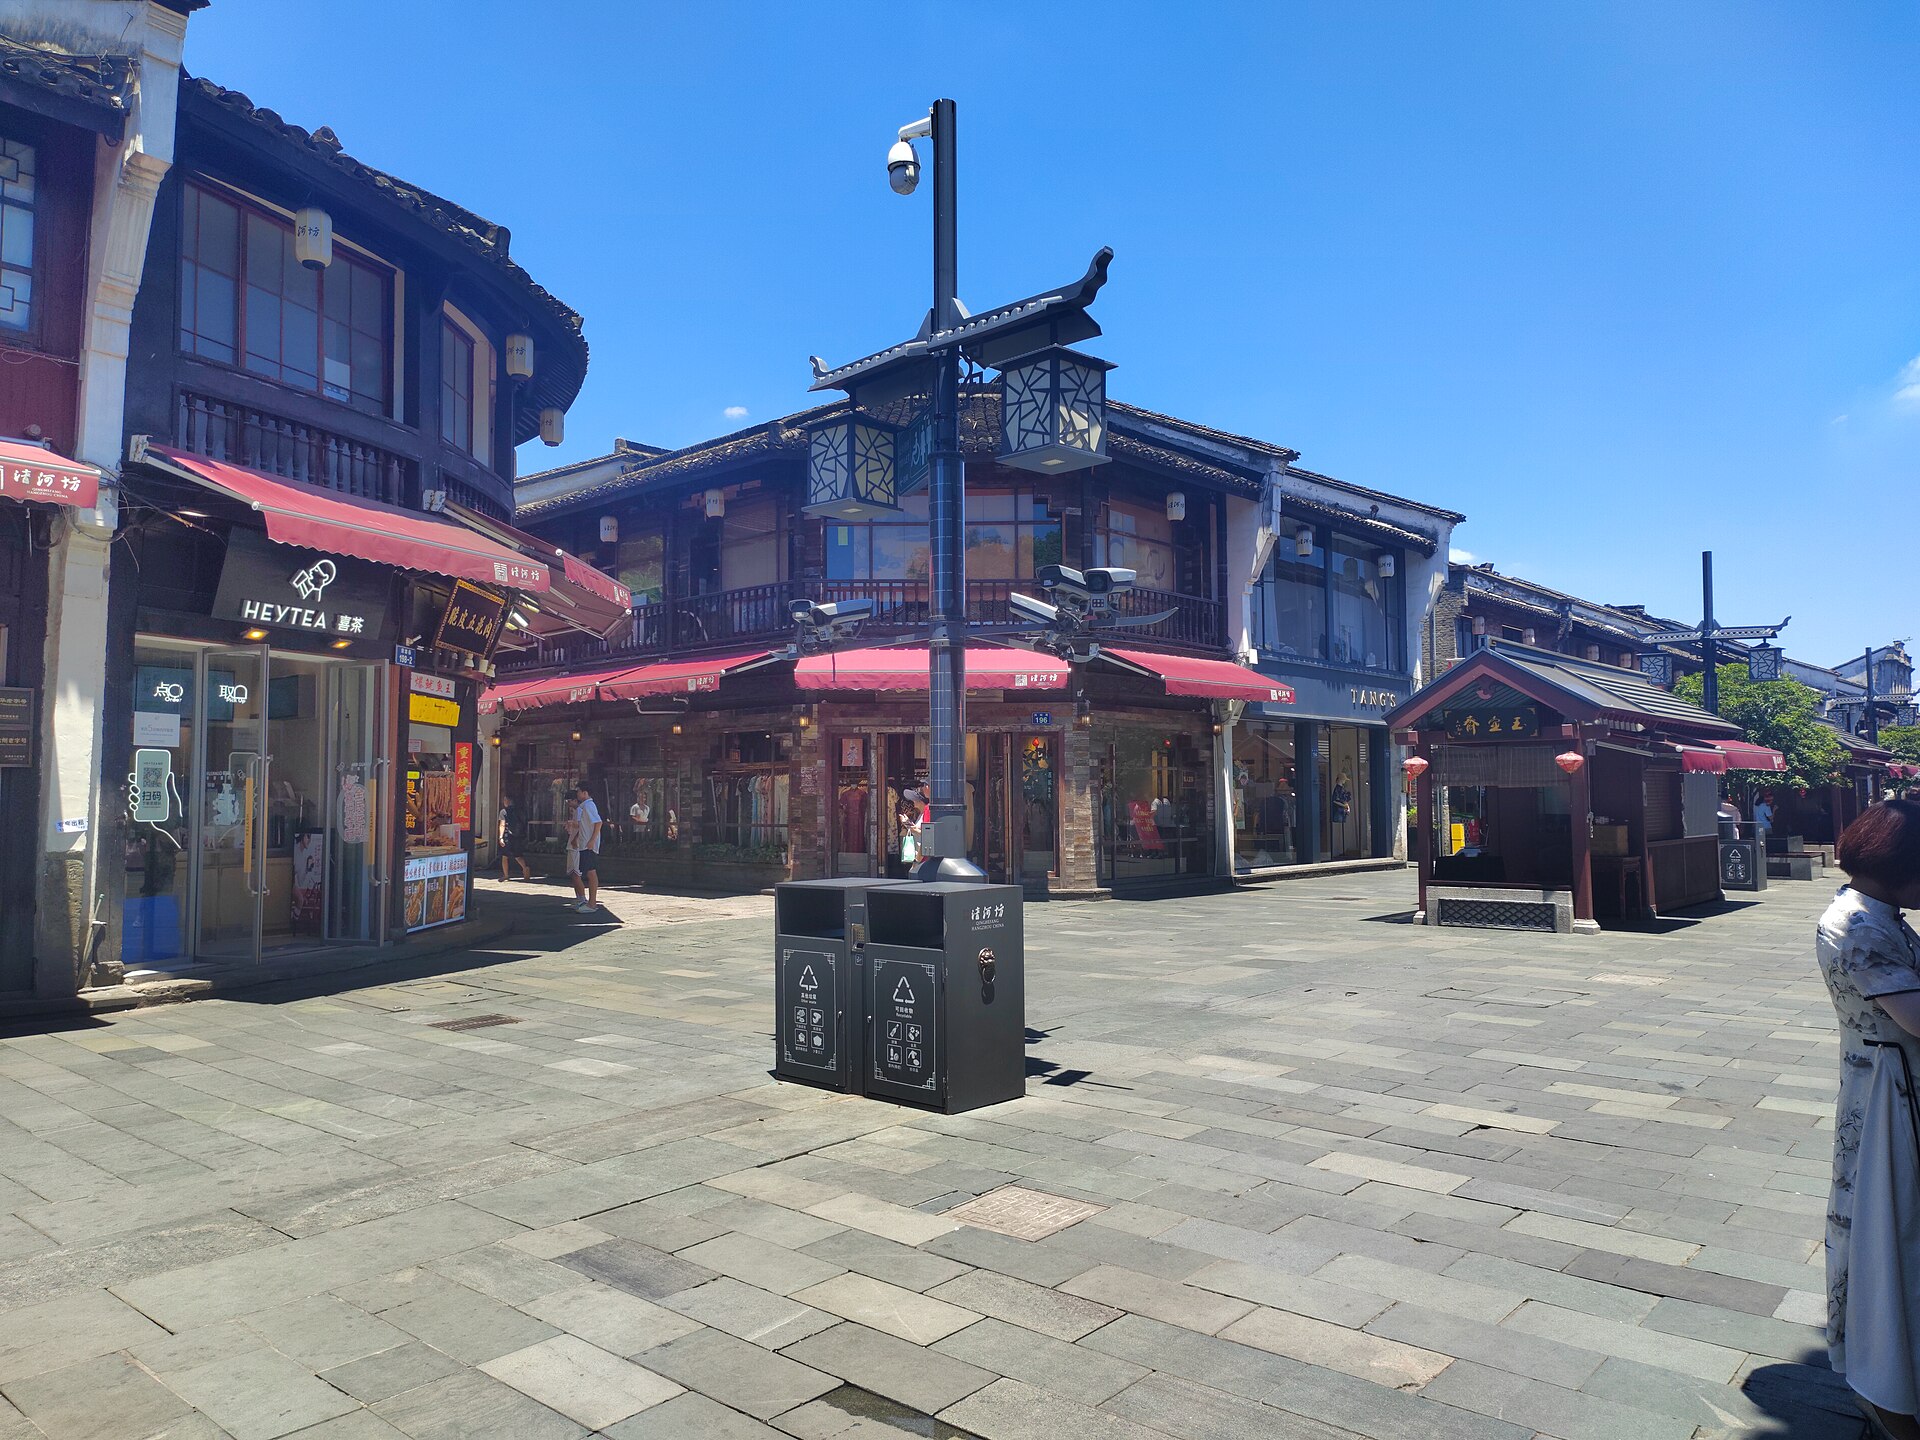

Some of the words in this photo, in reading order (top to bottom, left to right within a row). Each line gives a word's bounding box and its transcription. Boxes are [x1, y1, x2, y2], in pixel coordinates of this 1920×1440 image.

[13, 469, 81, 492] 清河坊
[243, 600, 327, 630] HEYTEA
[337, 614, 365, 634] 喜茶
[1350, 688, 1397, 707] TANG'S
[1036, 716, 1048, 724] 196
[142, 790, 162, 801] 扫码
[971, 903, 1005, 920] 清河坊
